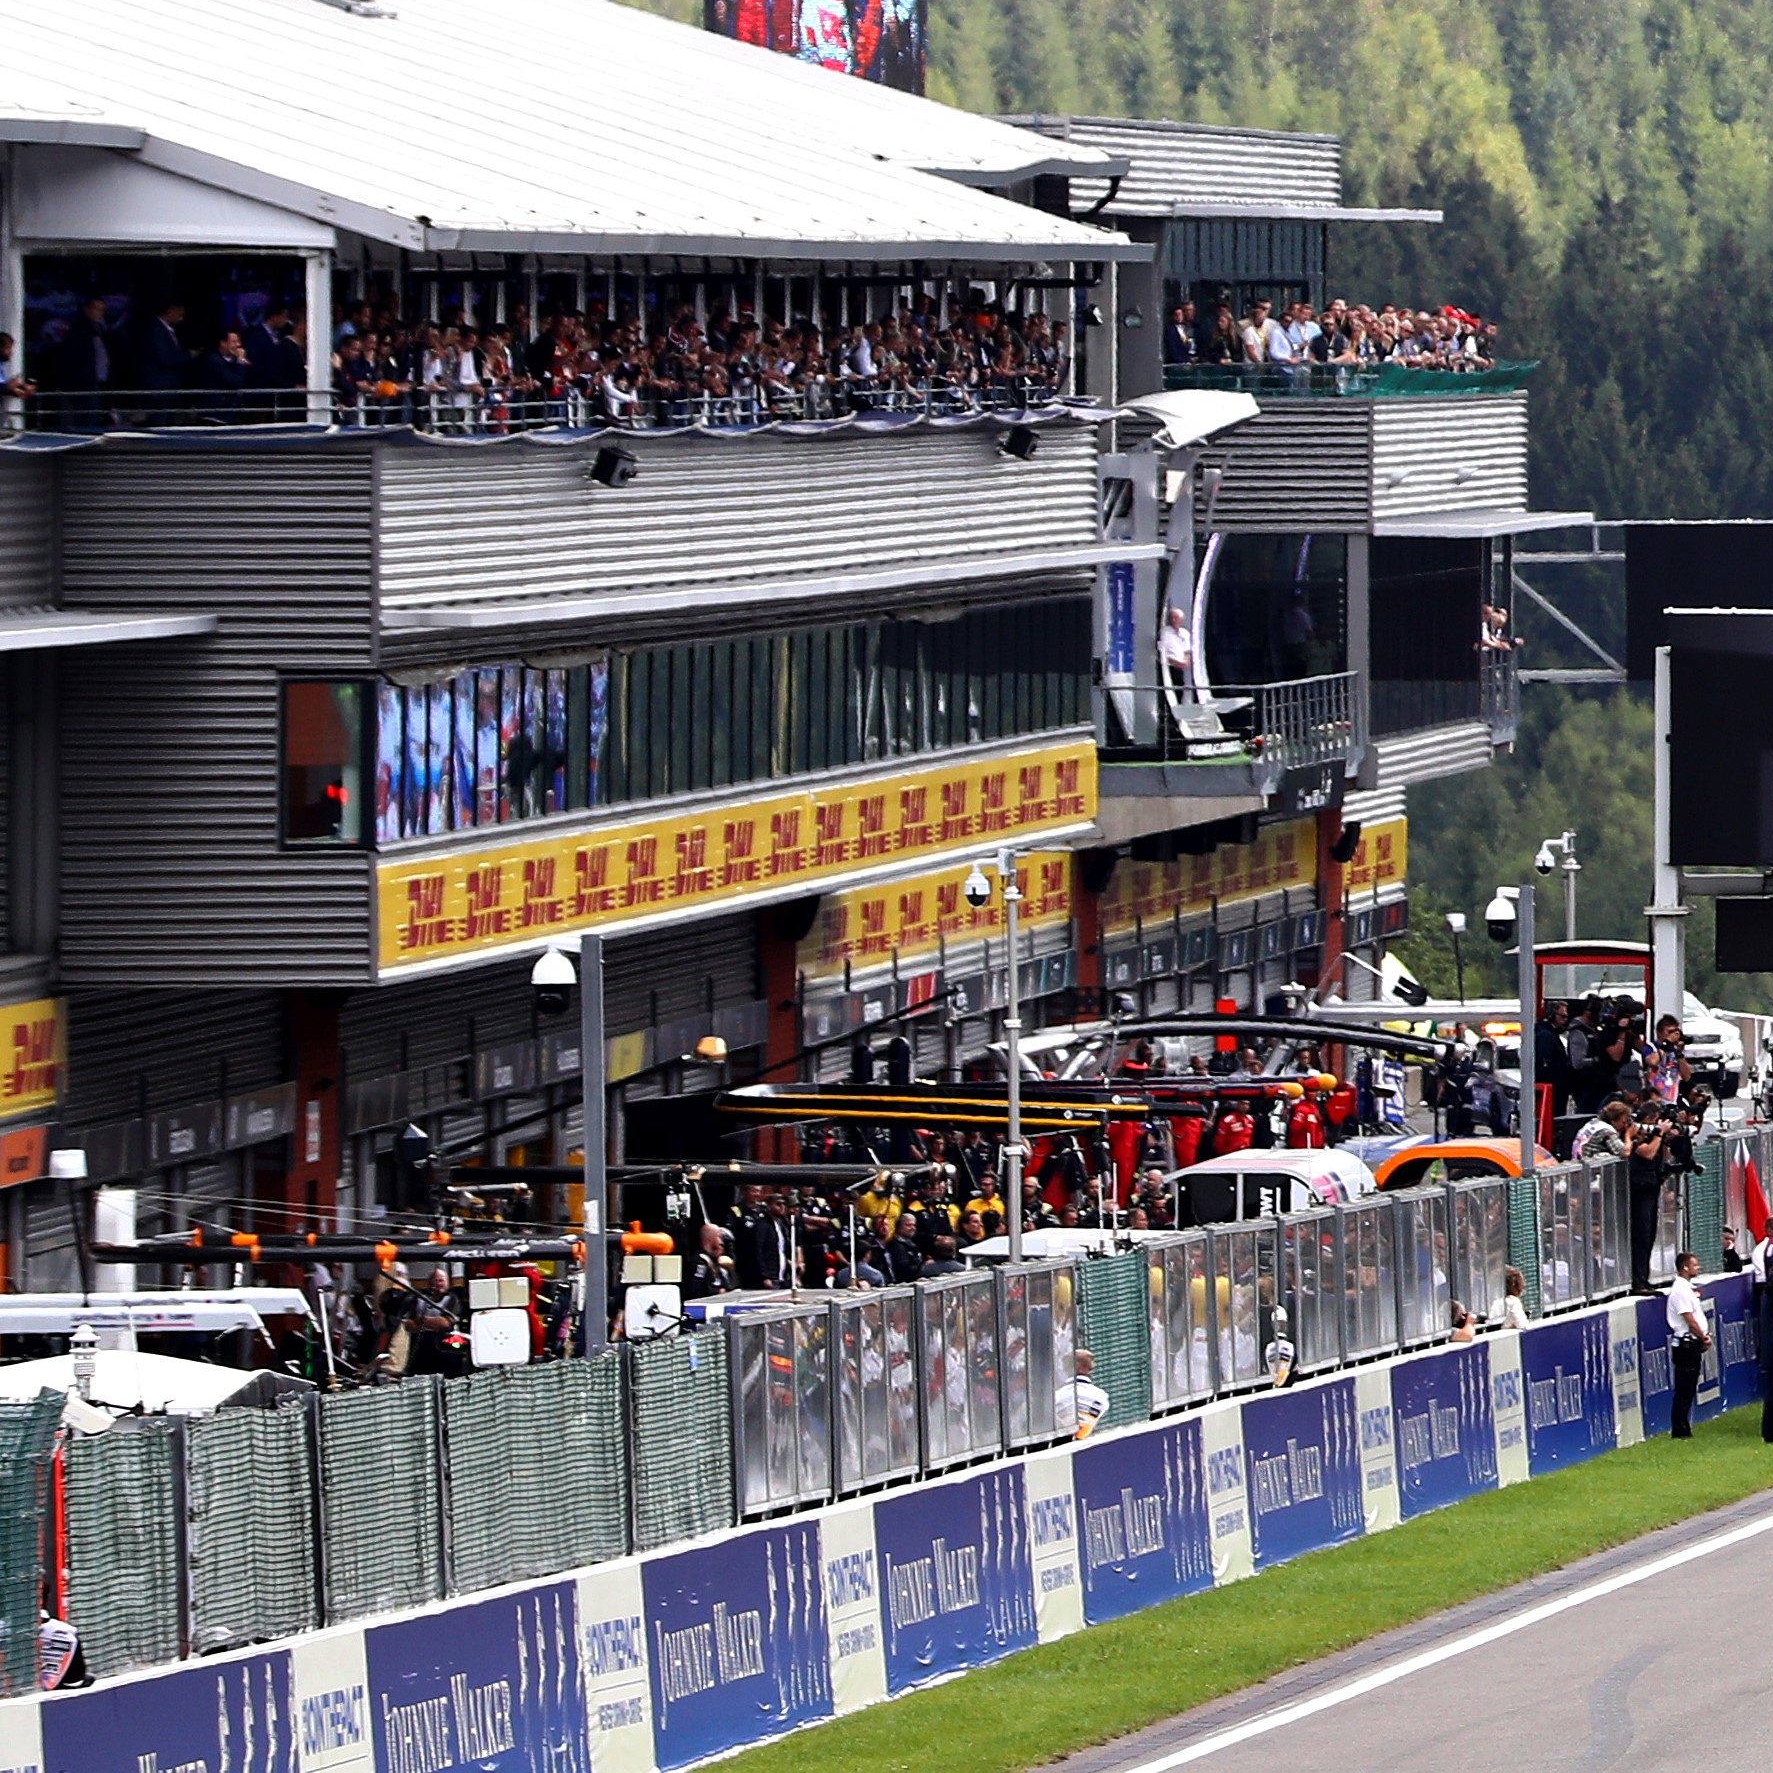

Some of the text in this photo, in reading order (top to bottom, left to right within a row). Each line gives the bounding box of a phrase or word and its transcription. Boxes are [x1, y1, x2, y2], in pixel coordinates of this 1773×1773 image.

[450, 1673, 516, 1765] WALKER
[655, 1601, 766, 1730] JOHNNIE WALKER
